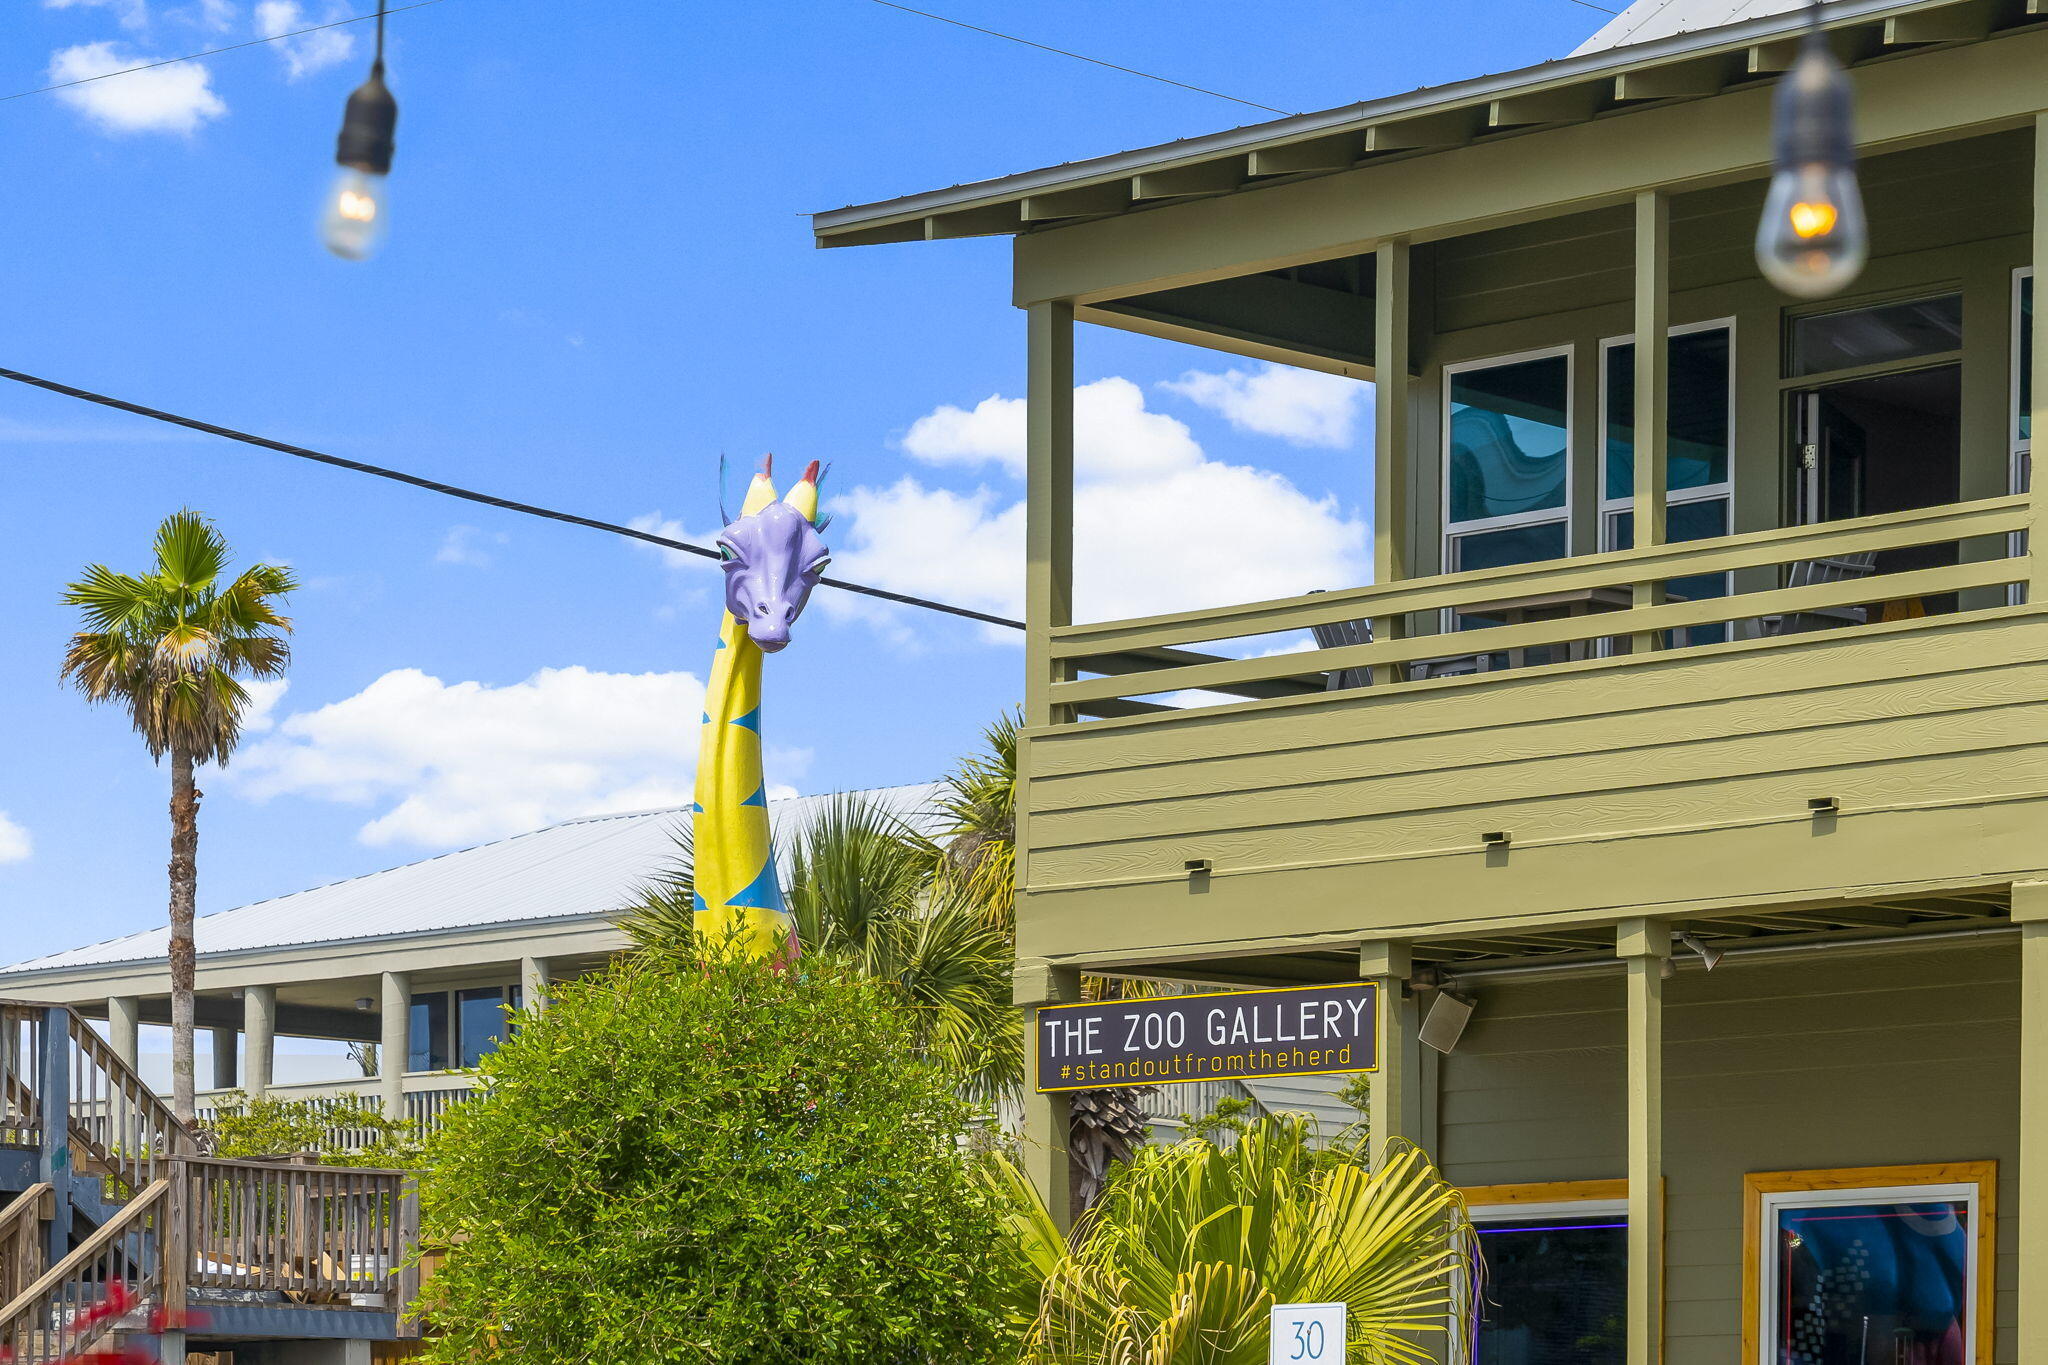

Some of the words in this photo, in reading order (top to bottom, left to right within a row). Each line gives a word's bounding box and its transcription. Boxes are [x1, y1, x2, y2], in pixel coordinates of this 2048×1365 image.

[1044, 1017, 1103, 1058] THE
[1123, 1011, 1186, 1052] ZOO
[1206, 998, 1368, 1046] GALLERY
[1060, 1044, 1352, 1081] #standoutfromtheherd
[1290, 1320, 1325, 1360] 30
